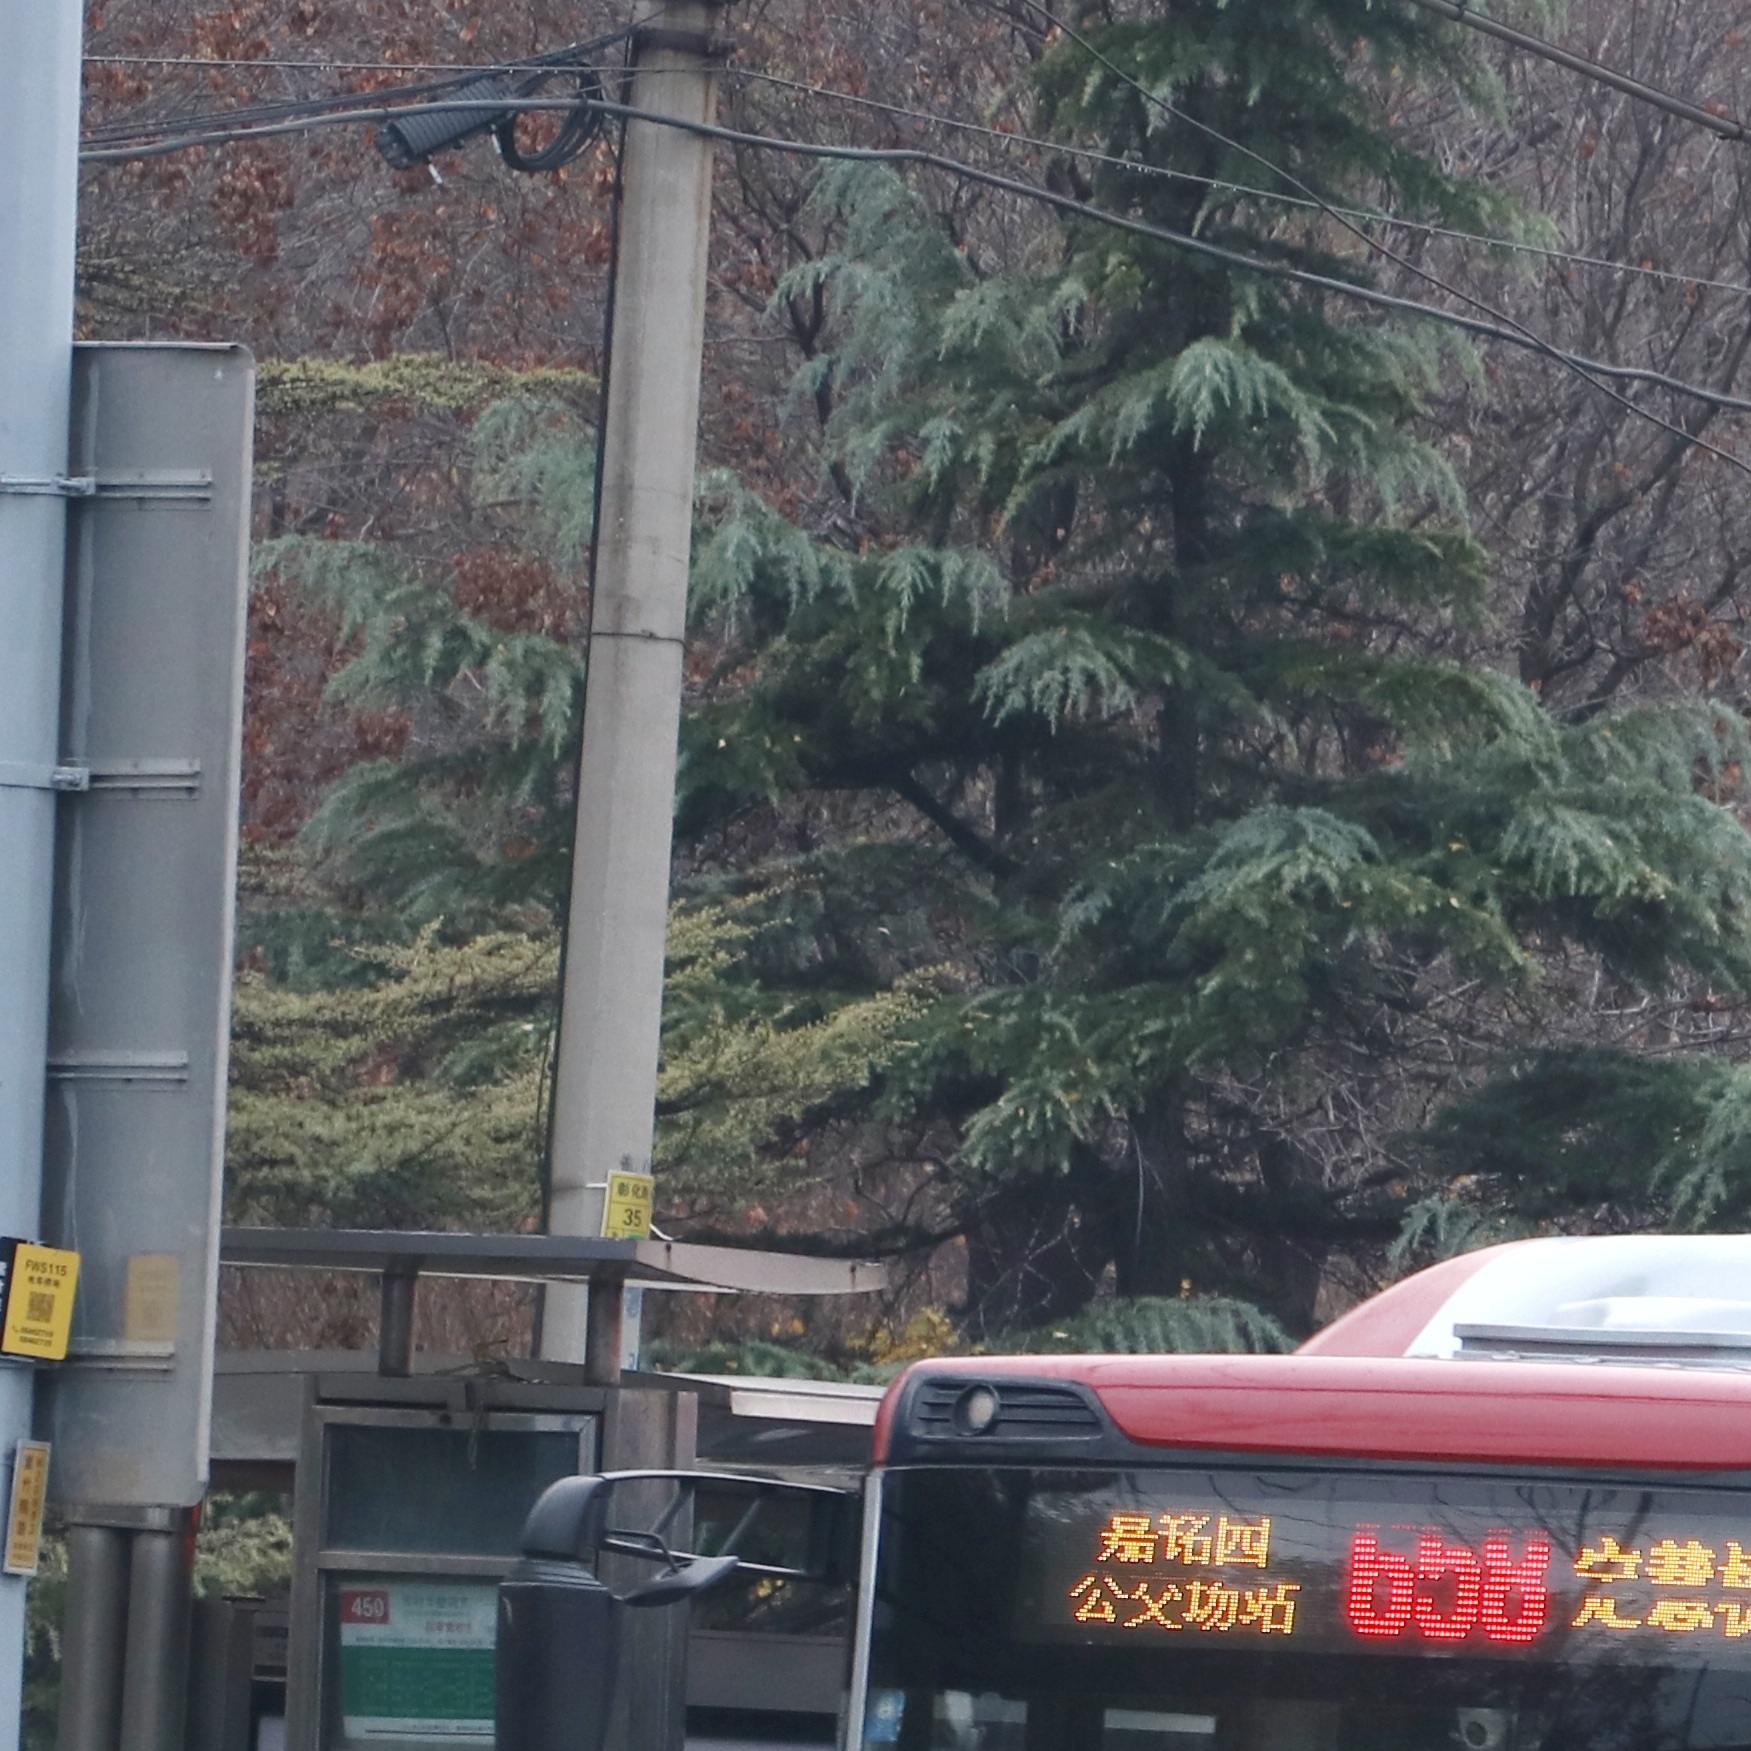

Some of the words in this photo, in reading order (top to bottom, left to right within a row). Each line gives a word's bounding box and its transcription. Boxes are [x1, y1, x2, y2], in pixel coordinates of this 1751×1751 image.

[623, 1208, 642, 1228] 35
[25, 1259, 67, 1277] FWS115
[1348, 1526, 1550, 1642] 658
[351, 1596, 385, 1618] 450
